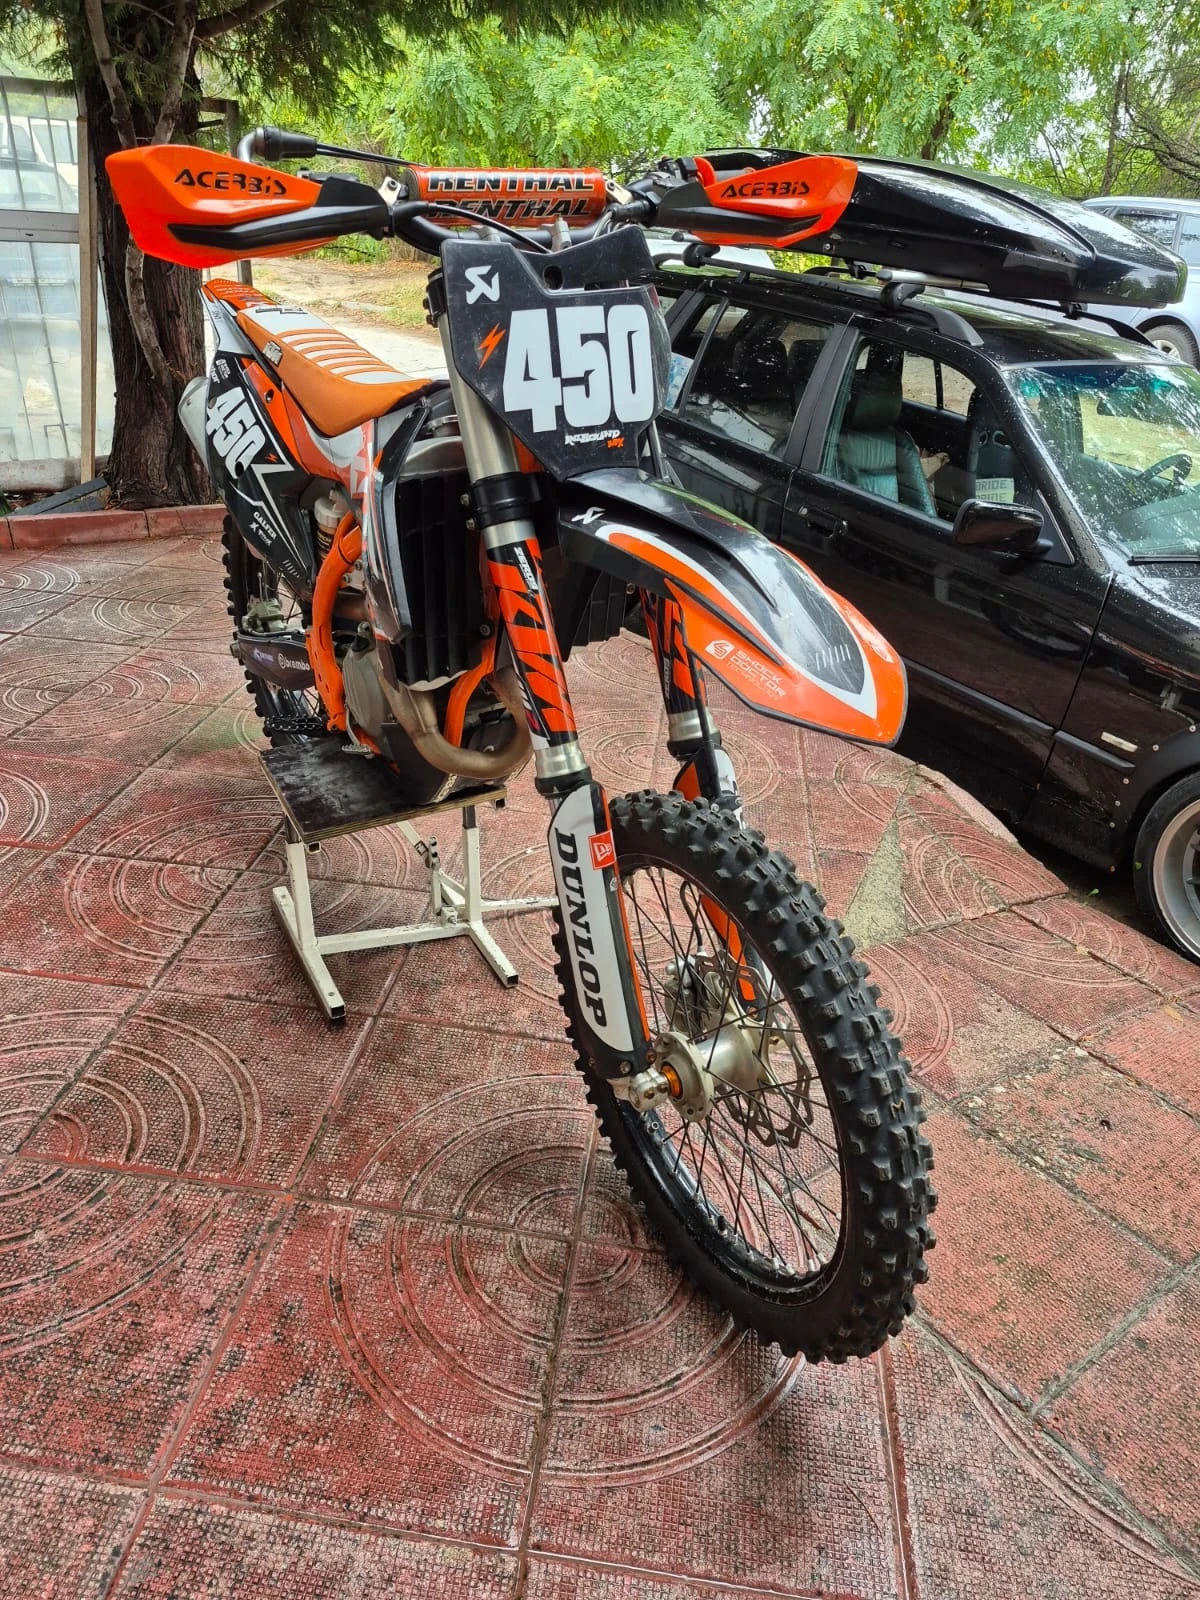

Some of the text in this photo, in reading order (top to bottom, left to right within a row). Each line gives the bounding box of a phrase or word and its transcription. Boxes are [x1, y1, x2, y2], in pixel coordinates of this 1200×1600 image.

[428, 172, 595, 192] RENTHAL
[503, 304, 654, 433] 450
[206, 387, 266, 479] 450
[730, 655, 786, 697] DOCTOR
[736, 649, 783, 685] SHOCK
[555, 827, 607, 1027] DUNLOP
